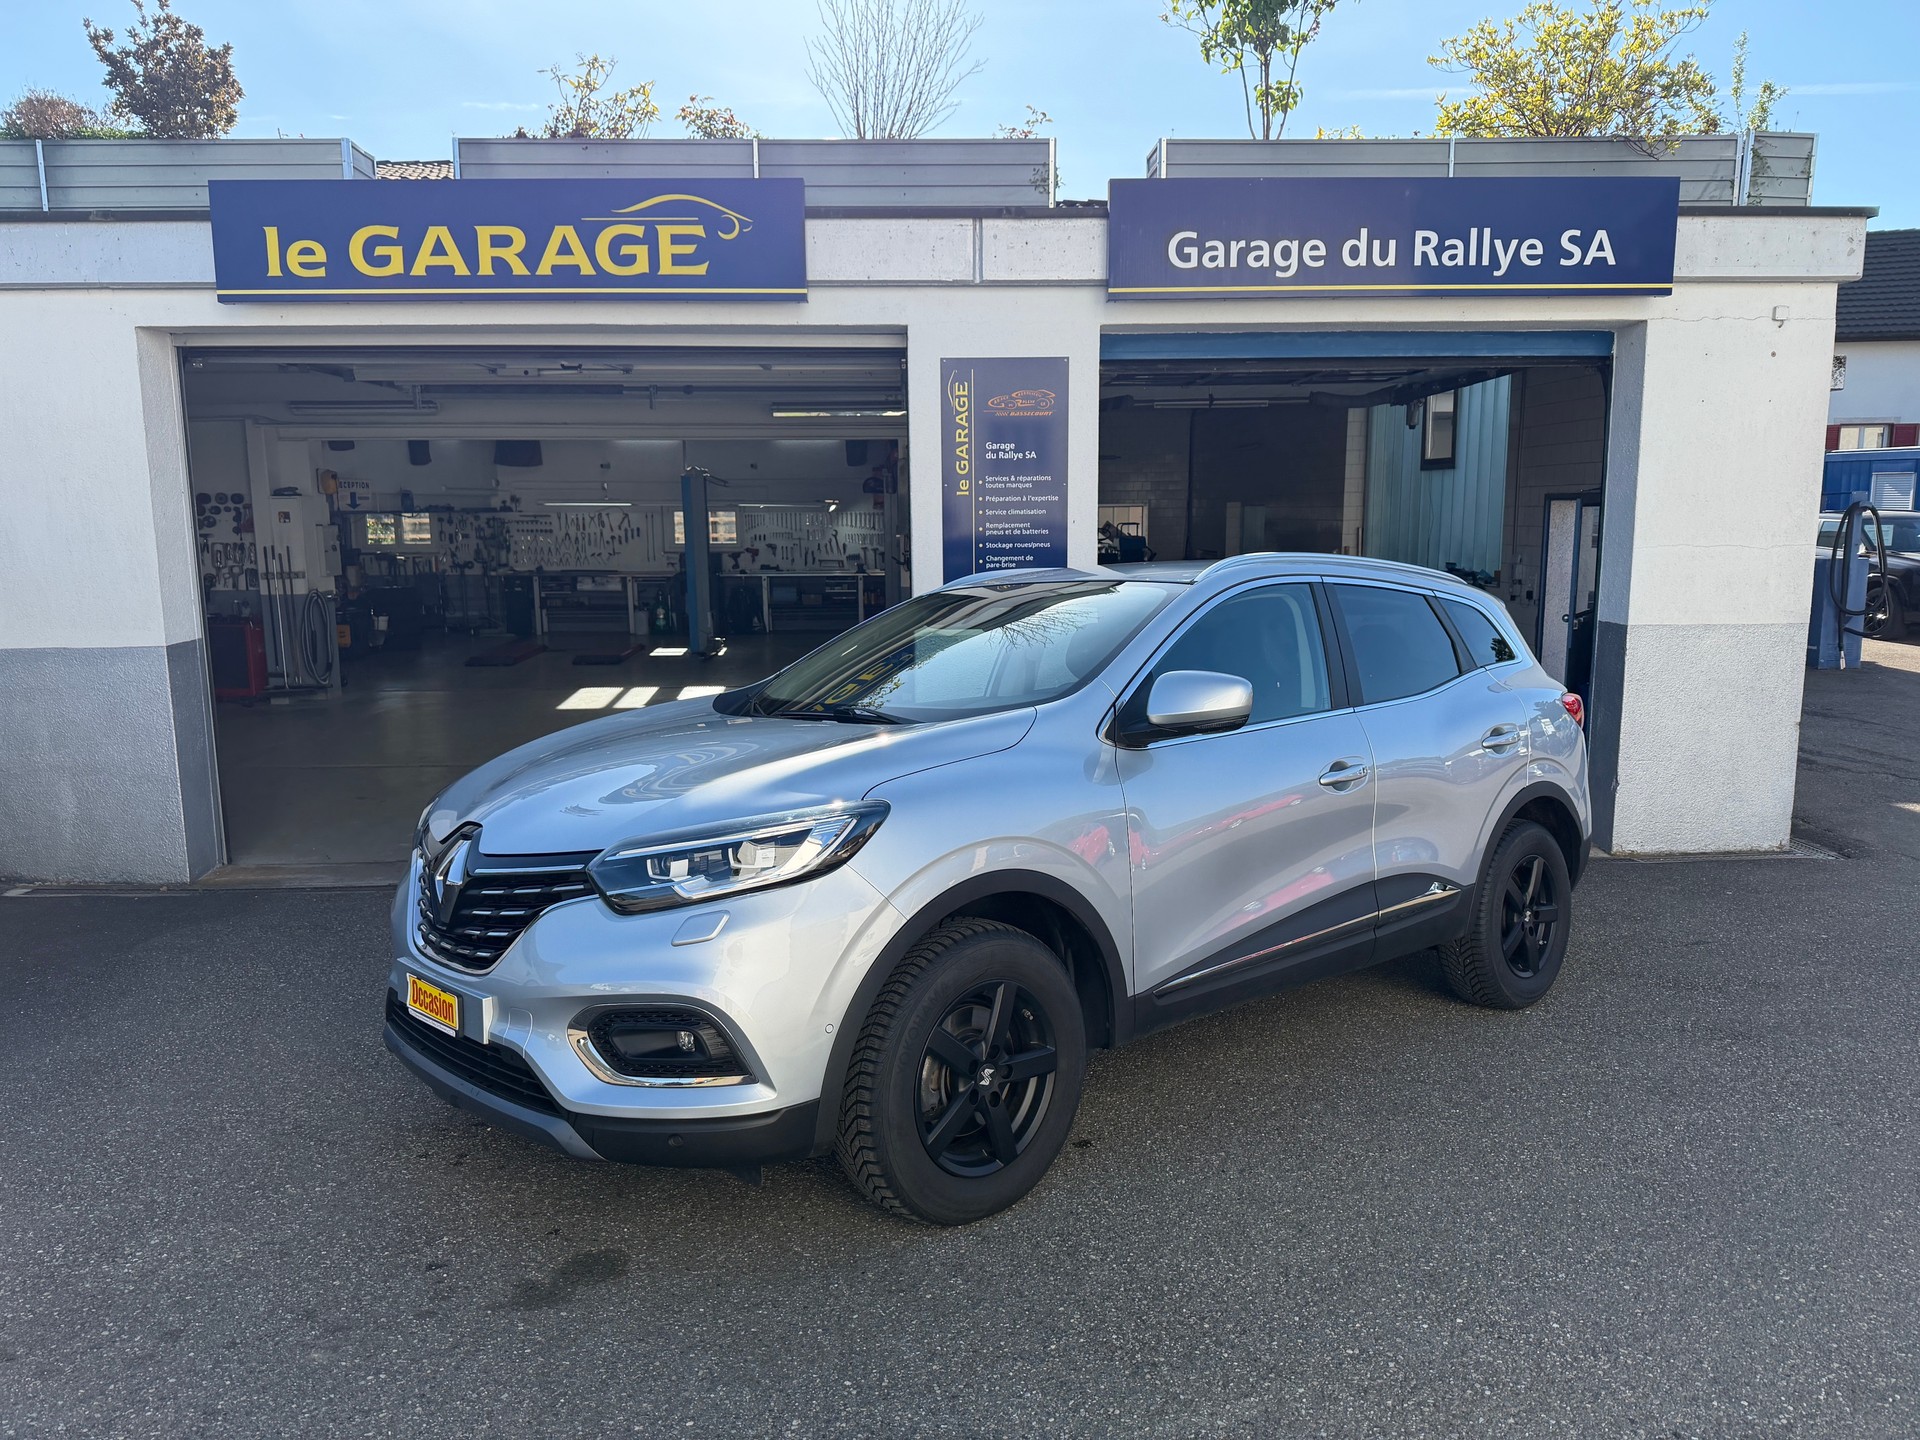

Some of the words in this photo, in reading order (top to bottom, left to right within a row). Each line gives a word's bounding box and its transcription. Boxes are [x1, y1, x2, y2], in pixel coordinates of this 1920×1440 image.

[262, 226, 328, 278] le
[348, 223, 710, 278] GARAGE
[1167, 230, 1328, 278] Garage
[1341, 227, 1397, 268] du
[1413, 227, 1544, 277] Rallye
[1559, 229, 1617, 266] SA
[955, 381, 970, 475] GARAGE
[985, 441, 1016, 452] Garage
[985, 450, 997, 460] du
[998, 450, 1024, 461] Rallye
[1025, 450, 1037, 459] SA
[1016, 474, 1052, 483] réparations
[956, 479, 970, 496] le
[1006, 482, 1033, 490] marques
[985, 495, 1022, 503] Préparation
[1027, 494, 1059, 503] l'expertise
[985, 508, 1007, 516] Service
[985, 522, 1031, 530] Remplacement
[985, 529, 1005, 537] pneus
[985, 541, 1014, 550] Stockage
[1014, 541, 1051, 549] roues/pneus
[985, 555, 1025, 563] Changement
[985, 561, 1017, 570] pare-brise
[411, 979, 455, 1024] Occasion
